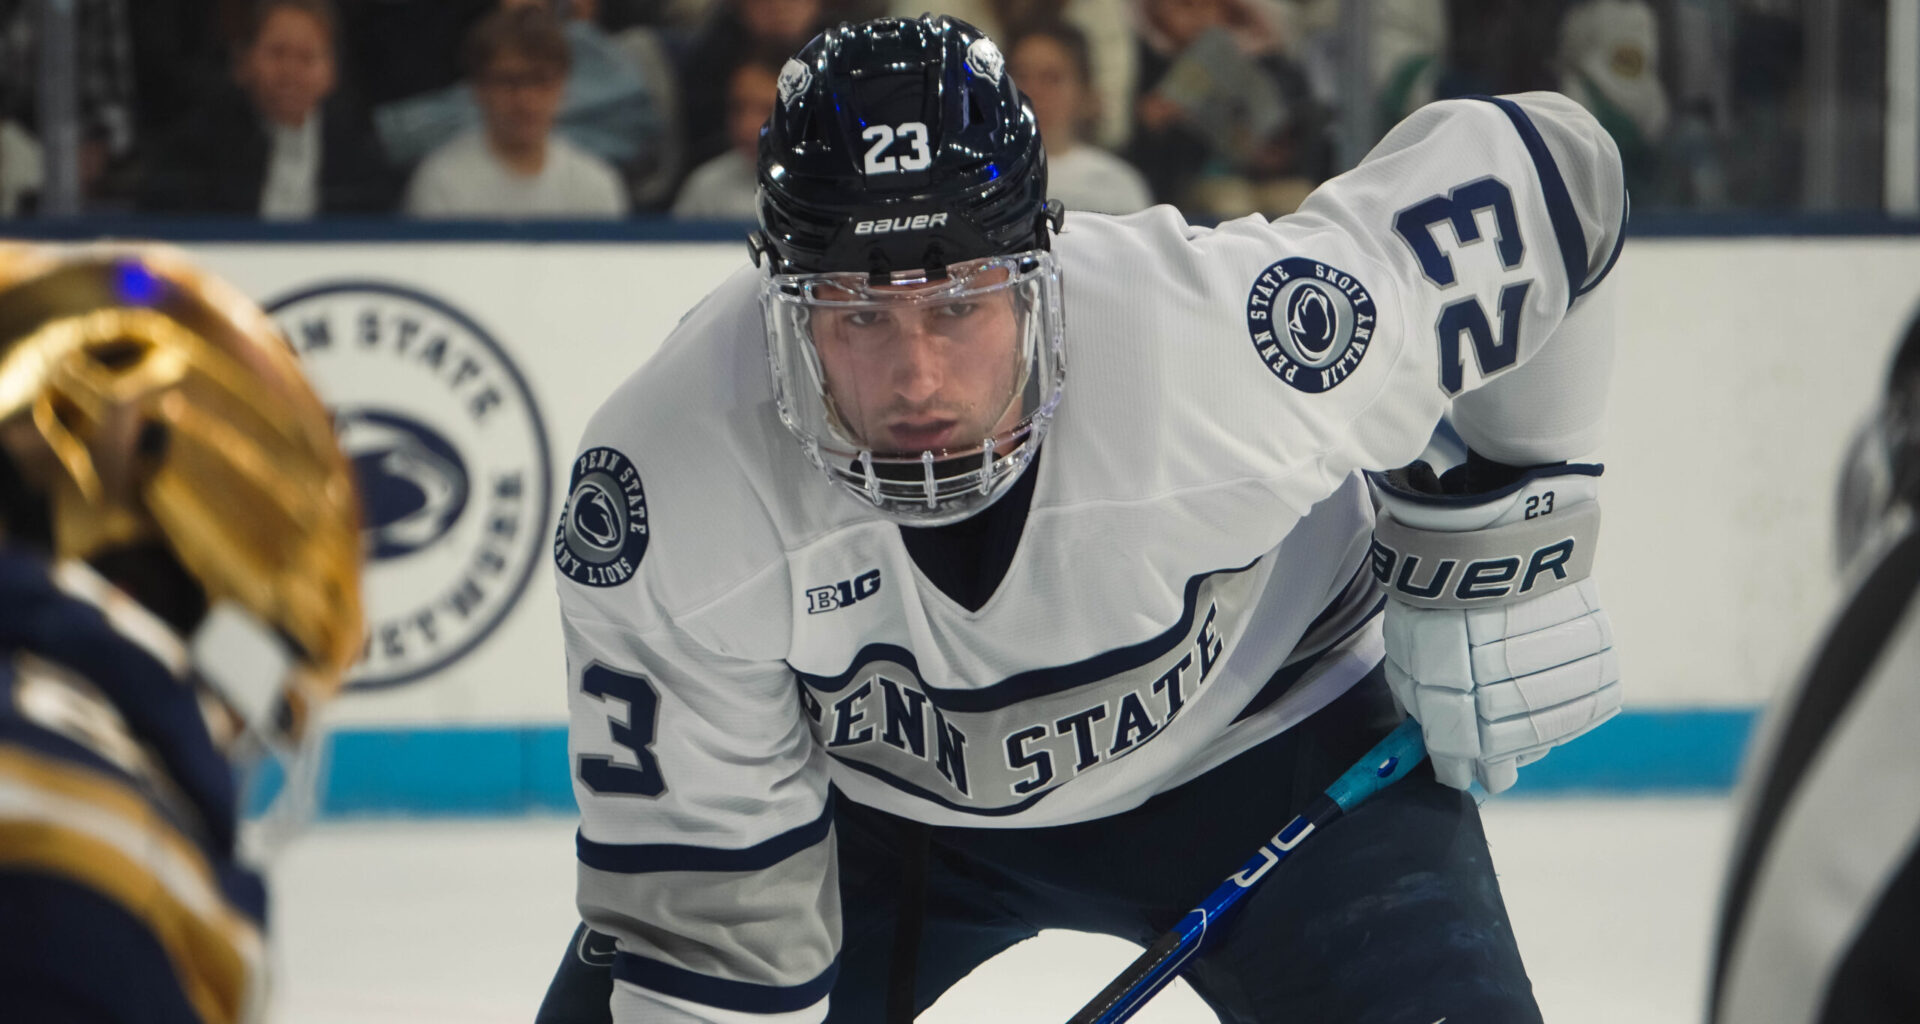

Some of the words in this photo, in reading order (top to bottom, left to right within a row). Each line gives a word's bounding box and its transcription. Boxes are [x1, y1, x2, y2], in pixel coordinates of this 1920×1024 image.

[862, 122, 931, 175] 23
[1250, 265, 1290, 320] STATE
[1315, 264, 1369, 306] LIONS
[1391, 174, 1535, 400] 23
[1254, 330, 1299, 383] PENN
[1321, 313, 1374, 389] NITTANY
[580, 450, 620, 474] PENN
[619, 467, 647, 535] STATE
[1525, 491, 1555, 521] 23
[587, 557, 633, 585] LIONS
[1371, 535, 1576, 601] AUER
[1003, 598, 1225, 796] STATE
[572, 658, 669, 801] 3
